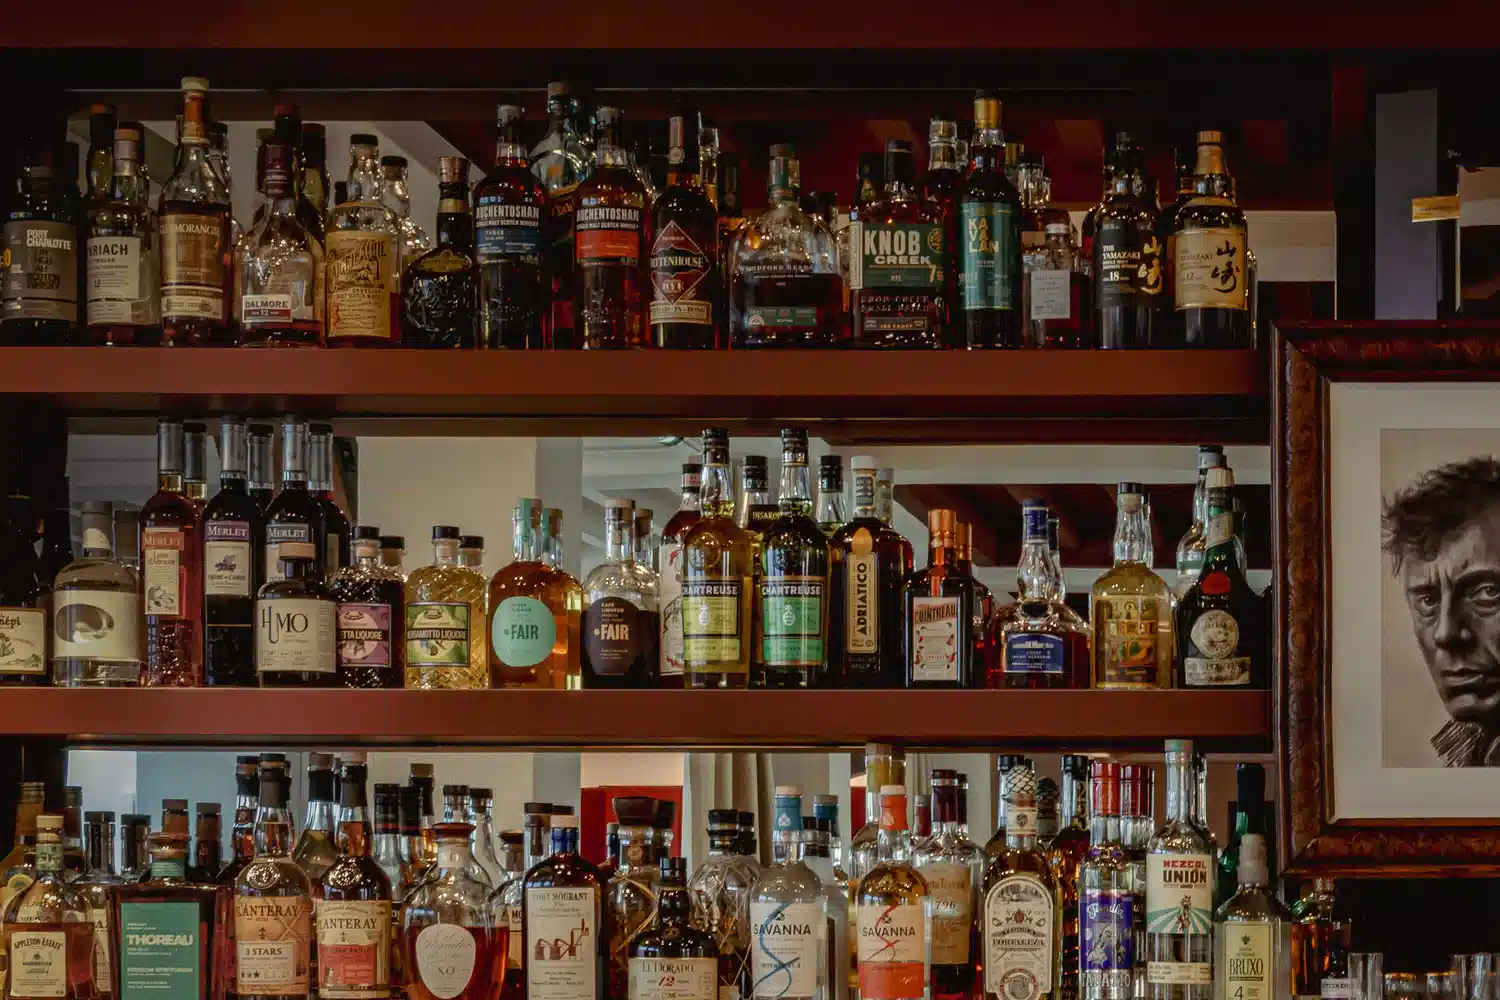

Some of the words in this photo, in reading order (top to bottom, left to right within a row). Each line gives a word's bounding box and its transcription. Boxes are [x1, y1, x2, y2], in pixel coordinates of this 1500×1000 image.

[475, 205, 540, 220] AUCHENTOSHAN
[576, 207, 640, 222] AUCHENTOSHAN
[27, 229, 48, 239] PORT
[27, 238, 73, 251] CHARLOTTE
[864, 230, 921, 255] KNOB
[878, 255, 932, 266] CREEK
[1102, 252, 1141, 260] YAMAZAKI
[245, 301, 289, 310] DALMORE
[207, 526, 249, 538] MERLET
[267, 527, 306, 539] MERLET
[144, 533, 180, 546] MERLET
[762, 585, 822, 596] CHARTREUSE
[857, 562, 868, 636] ADRIATICO
[914, 604, 957, 624] COINTREAU
[355, 629, 384, 641] LIQUORE
[511, 624, 540, 640] FAIR
[600, 623, 629, 641] FAIR
[1162, 860, 1206, 869] MEZCAL
[753, 923, 813, 936] SAVANNA
[861, 926, 916, 938] SAVANNA
[13, 938, 41, 952] APPLETON
[41, 937, 64, 951] ESTATE
[126, 934, 194, 946] THOREAU
[252, 947, 283, 957] STARS
[656, 964, 696, 976] DORADO
[1229, 958, 1264, 975] BRUXO
[657, 976, 676, 987] 12
[1234, 985, 1244, 1000] 4
